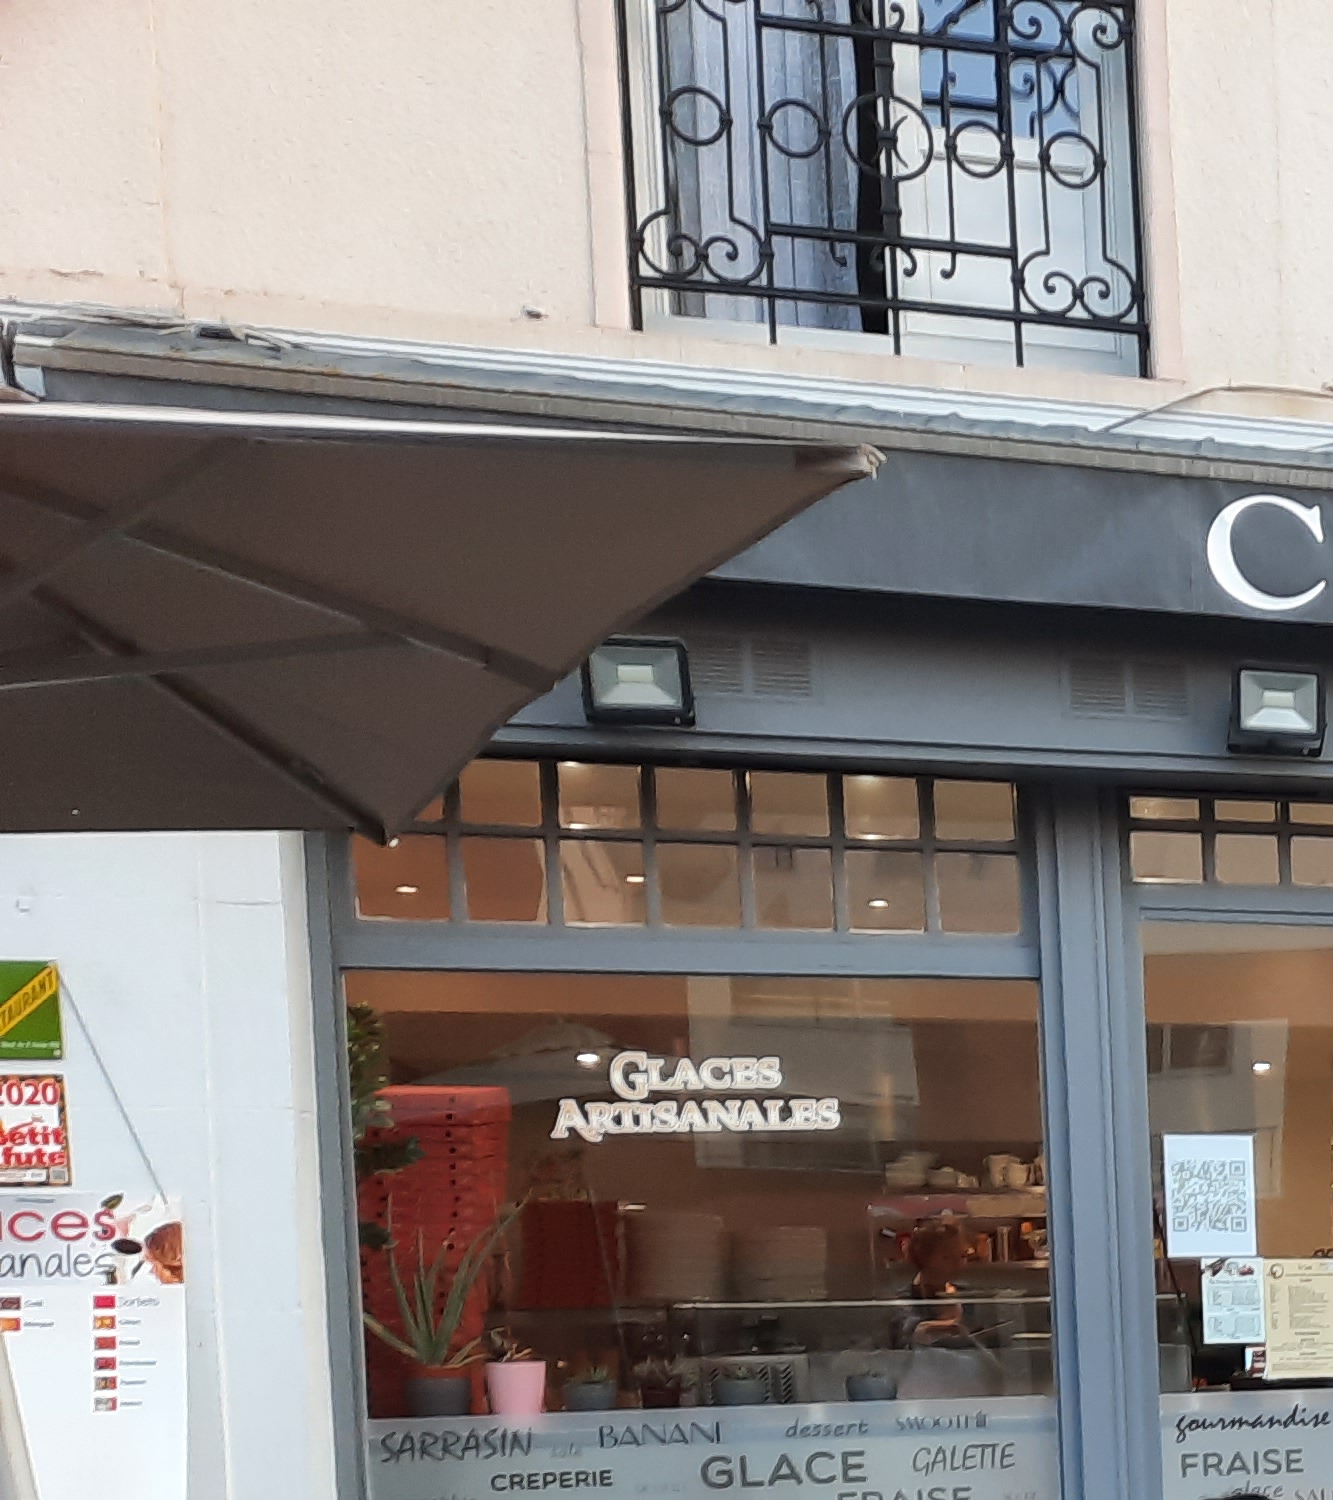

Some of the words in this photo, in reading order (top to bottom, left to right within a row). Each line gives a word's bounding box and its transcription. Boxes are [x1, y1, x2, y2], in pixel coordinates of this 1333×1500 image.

[0, 1081, 59, 1106] 020
[0, 1209, 117, 1242] ces
[0, 1244, 116, 1278] anales
[380, 1427, 533, 1463] SARRASIN
[785, 1417, 869, 1438] dessert
[1175, 1403, 1331, 1443] gourmandise
[490, 1469, 614, 1492] CREPERIE
[701, 1450, 868, 1489] GLACE
[912, 1441, 1016, 1477] GALETTE
[1180, 1448, 1305, 1479] FRAISE
